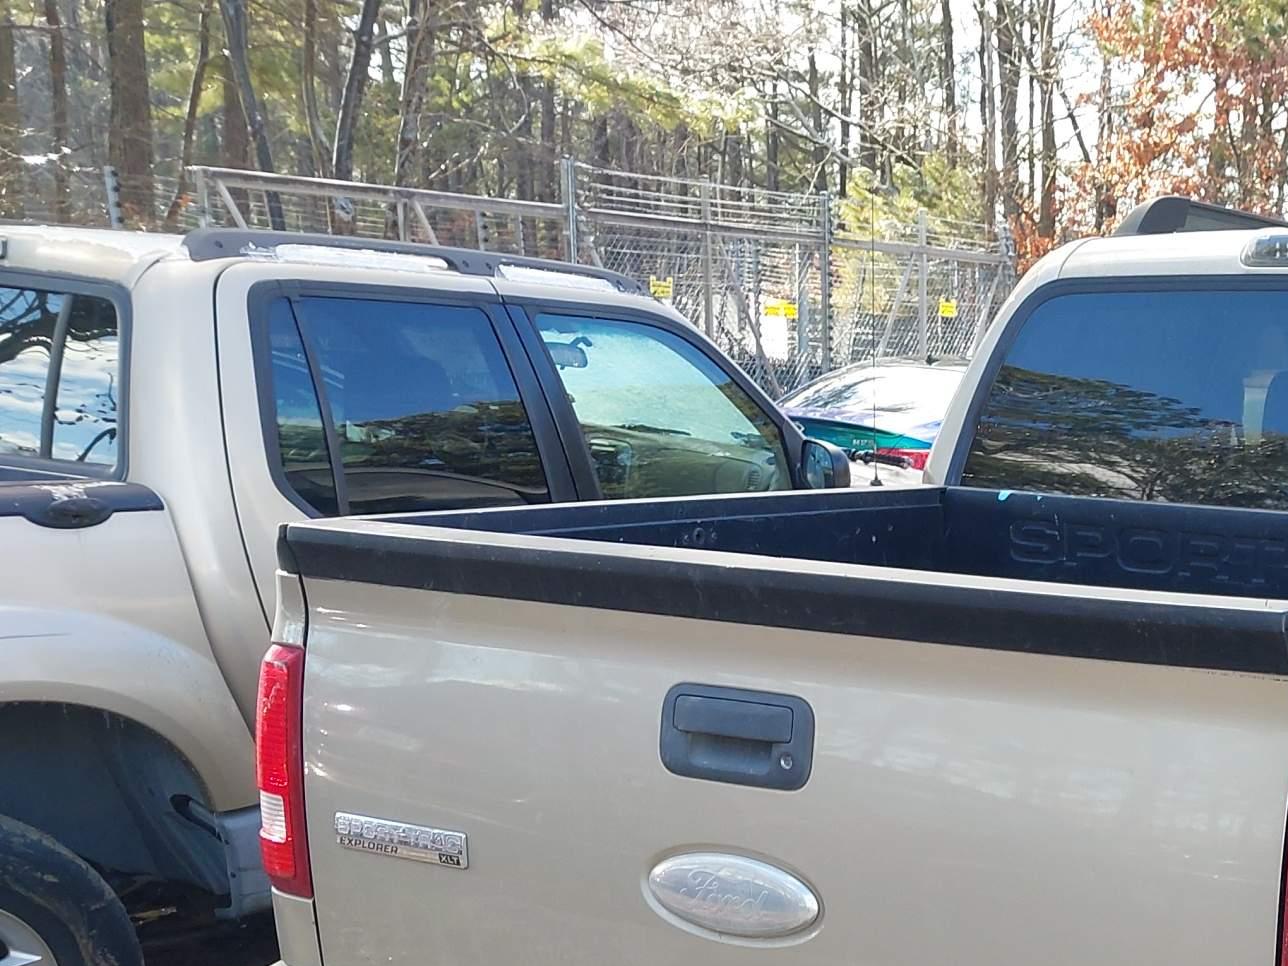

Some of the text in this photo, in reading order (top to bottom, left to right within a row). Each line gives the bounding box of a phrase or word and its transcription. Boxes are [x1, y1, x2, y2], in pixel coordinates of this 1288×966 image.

[340, 836, 460, 866] EXPLORER XLT
[679, 868, 769, 921] Ford
